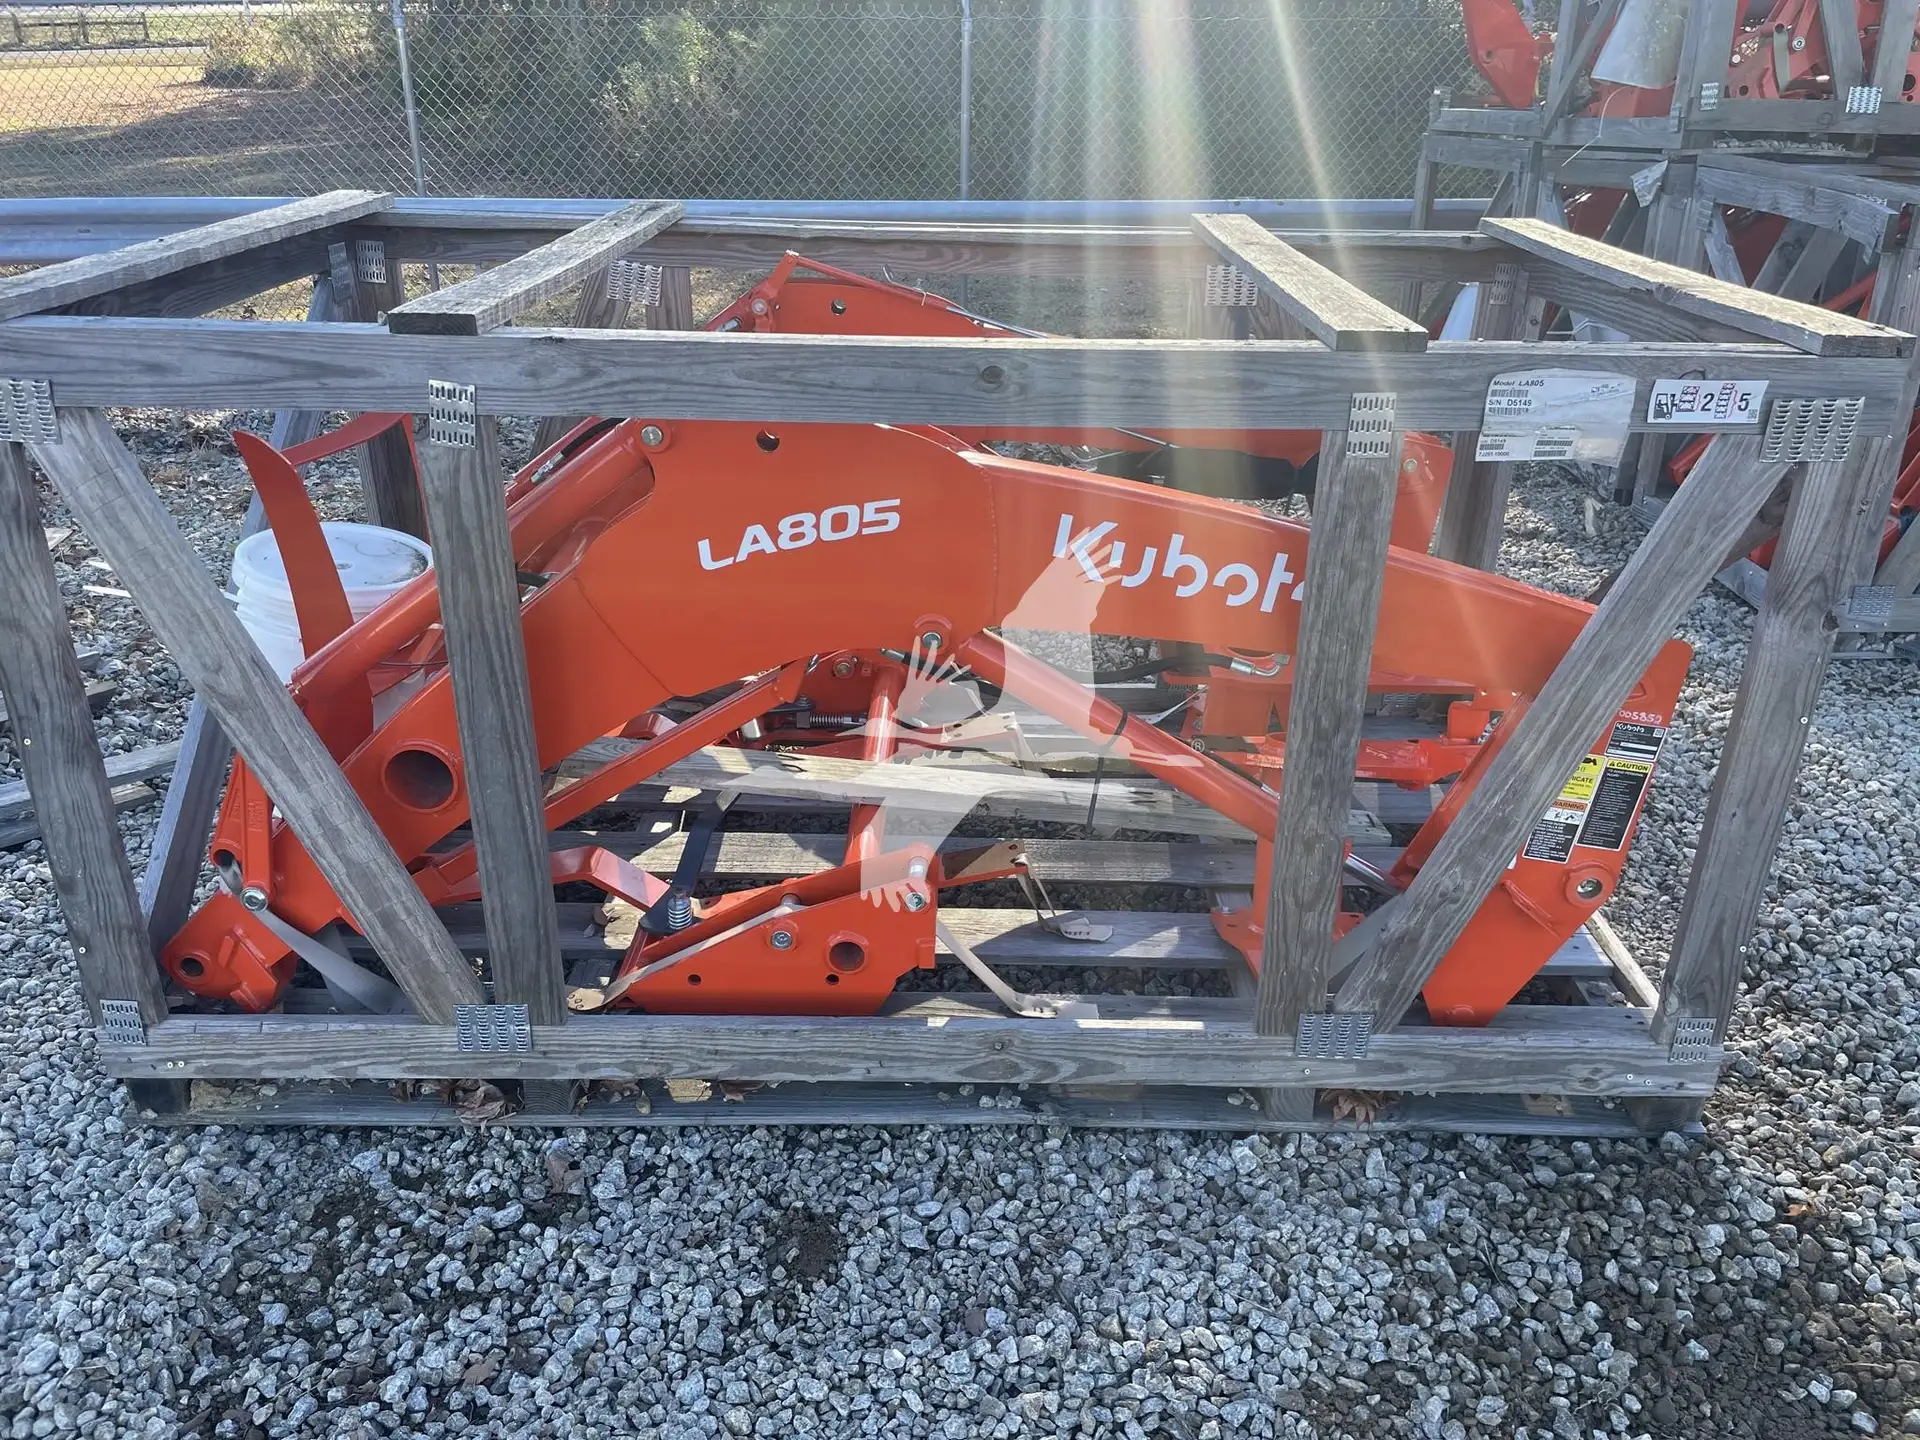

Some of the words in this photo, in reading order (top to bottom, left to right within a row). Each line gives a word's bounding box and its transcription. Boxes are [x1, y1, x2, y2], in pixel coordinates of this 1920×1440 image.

[1507, 399, 1532, 407] D5149
[1700, 393, 1715, 412] 2
[1737, 393, 1752, 412] 5
[697, 498, 901, 571] LA805
[1051, 513, 1305, 613] Kubot
[1616, 723, 1645, 733] Kubota
[1616, 761, 1649, 771] CAUTION
